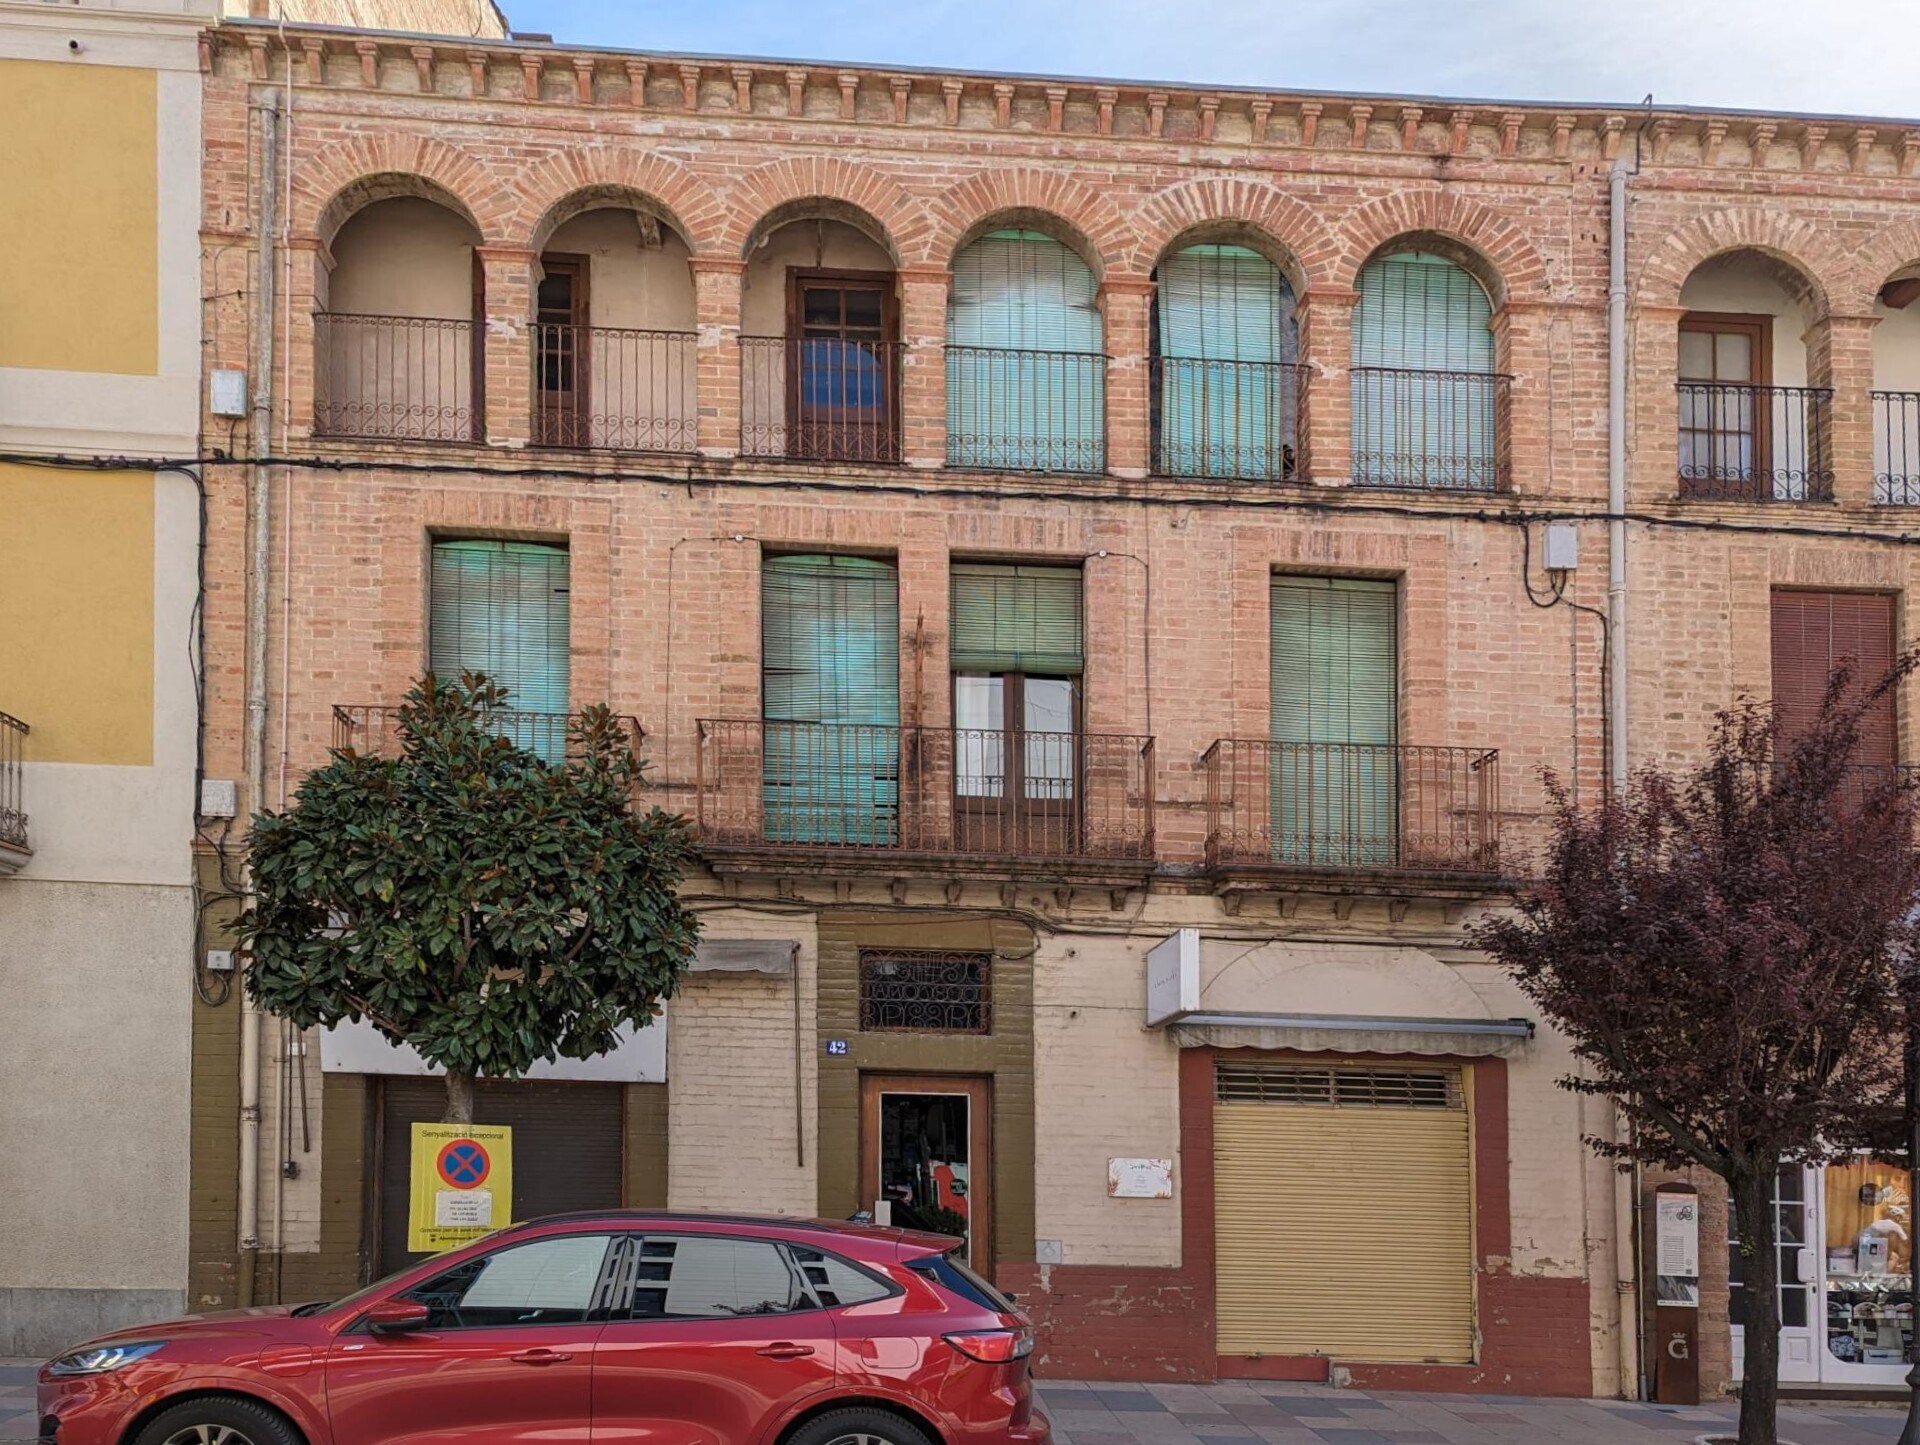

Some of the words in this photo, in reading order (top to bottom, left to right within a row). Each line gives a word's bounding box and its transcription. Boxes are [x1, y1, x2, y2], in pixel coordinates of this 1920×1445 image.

[829, 1040, 846, 1054] 42
[469, 1131, 504, 1140] excepcional
[1668, 1339, 1688, 1359] G
